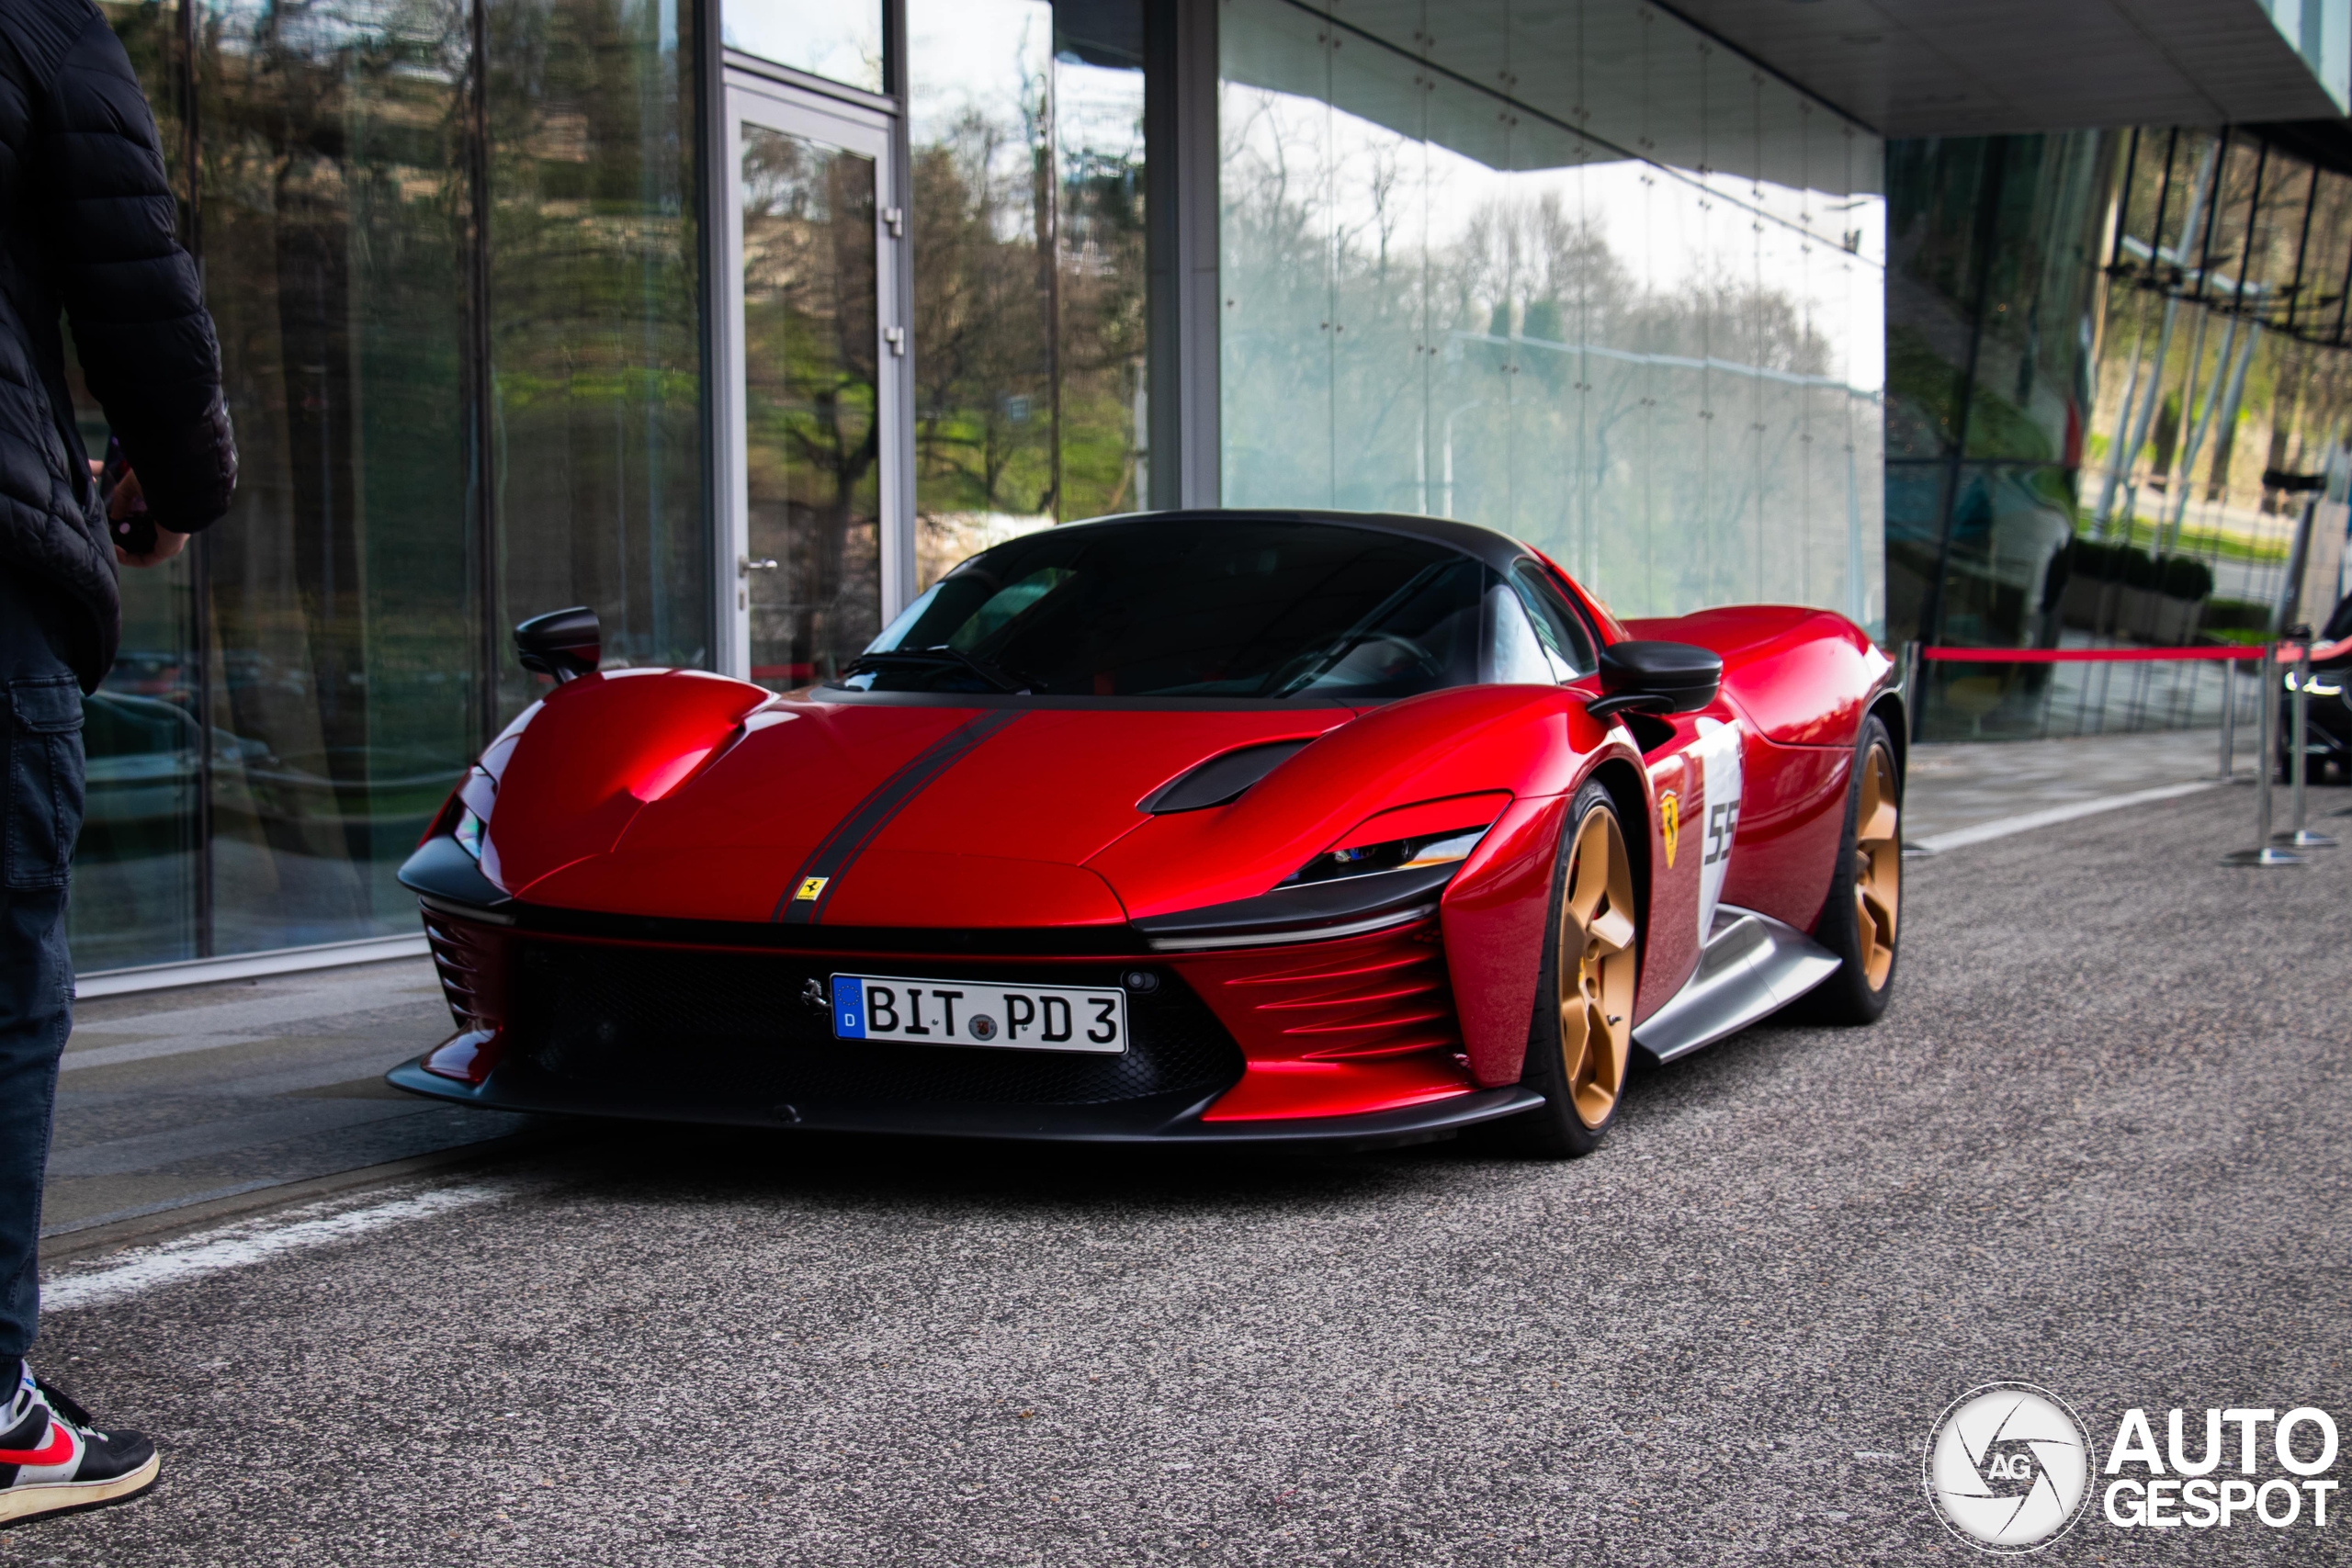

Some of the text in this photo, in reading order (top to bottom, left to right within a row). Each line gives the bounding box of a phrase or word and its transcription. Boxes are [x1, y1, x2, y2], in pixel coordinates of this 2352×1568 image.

[1704, 798, 1740, 865] 55
[844, 1013, 855, 1027] D
[866, 986, 1117, 1043] BIT PD 3
